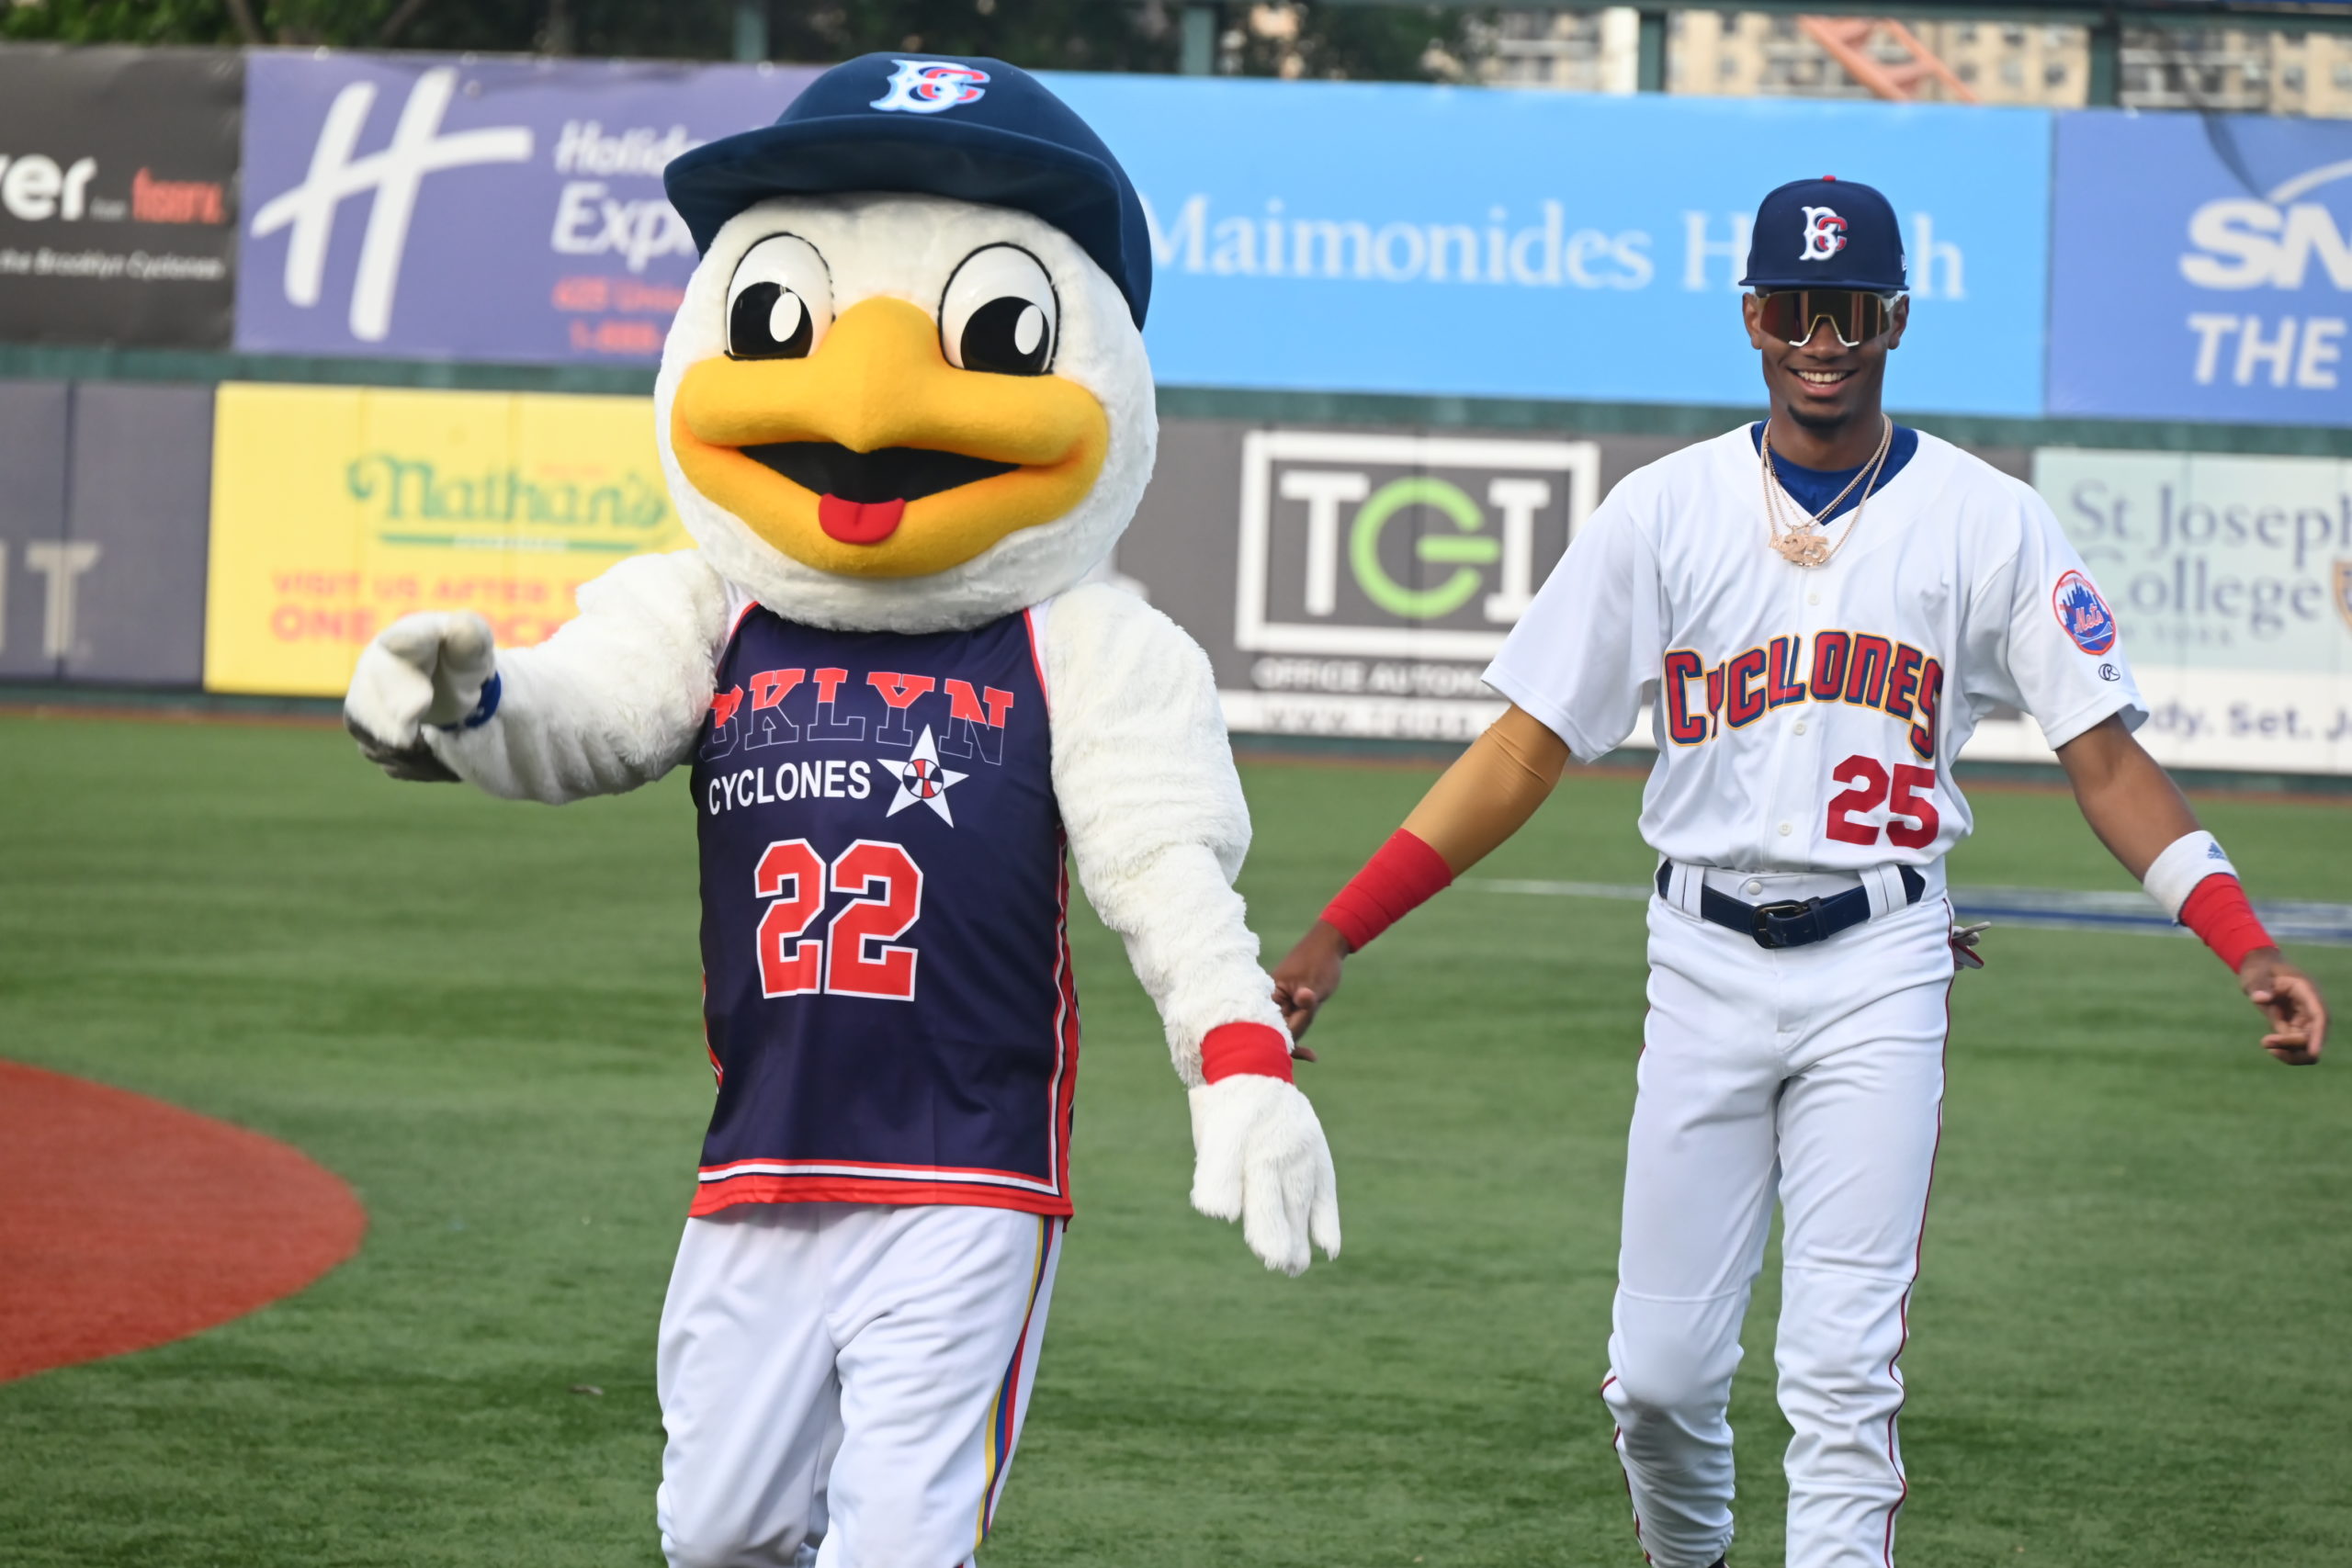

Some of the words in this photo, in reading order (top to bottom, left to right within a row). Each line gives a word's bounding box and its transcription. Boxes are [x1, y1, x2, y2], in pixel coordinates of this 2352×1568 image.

[554, 120, 706, 177] Holid
[1142, 193, 1653, 292] Maimonides
[2186, 313, 2346, 389] THE
[1280, 469, 1551, 623] TGI
[2070, 479, 2139, 542] St
[1663, 628, 1944, 761] CYCLONES
[708, 761, 871, 816] CYCLONES
[1826, 754, 1939, 850] 25
[753, 837, 924, 1002] 22
